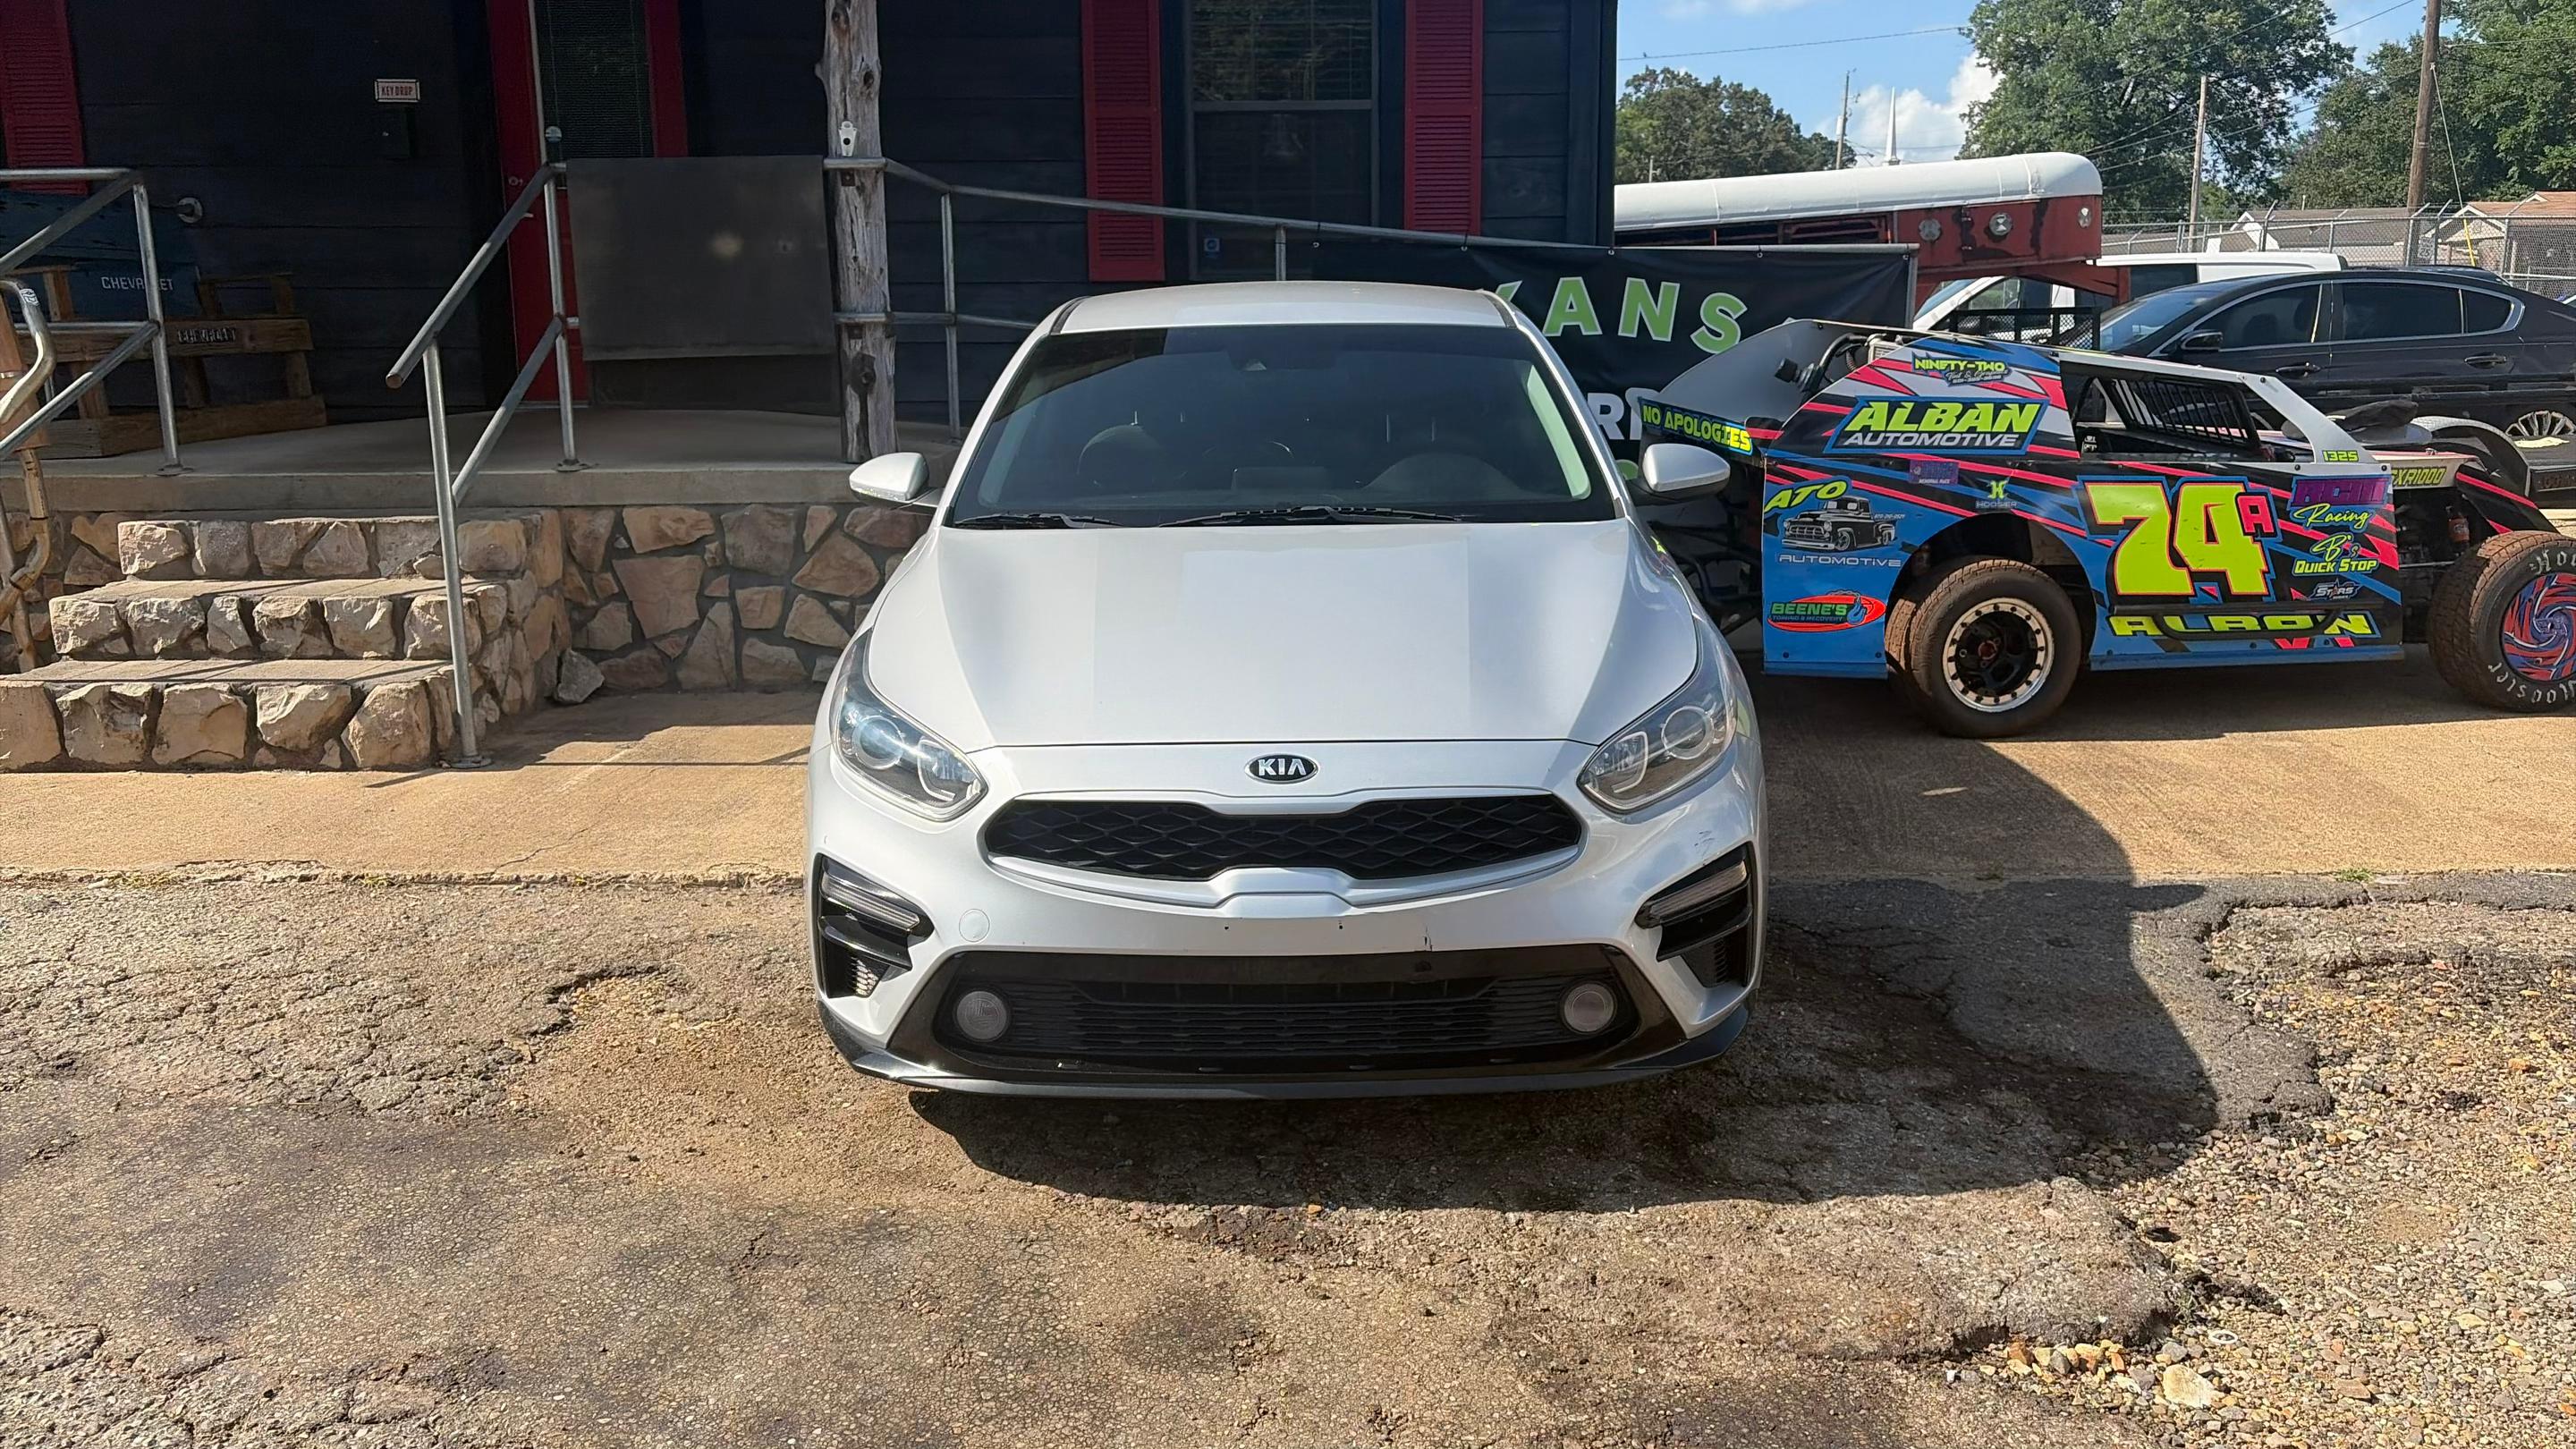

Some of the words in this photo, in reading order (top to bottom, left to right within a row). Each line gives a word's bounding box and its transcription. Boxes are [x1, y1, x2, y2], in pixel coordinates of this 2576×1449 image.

[381, 86, 394, 97] KEY
[394, 86, 412, 97] DROP
[101, 276, 174, 291] CHEVRET
[1845, 402, 2041, 432] ALBAN
[1643, 405, 1661, 425] NO
[1665, 411, 1751, 452] APOLOGIES
[1843, 432, 2020, 446] AUTOMOTIVE
[2323, 450, 2359, 462] 1325
[1764, 480, 1848, 512] ATO
[2293, 503, 2370, 529] Racing
[1779, 555, 1902, 567] AUTOMOTIVE
[1771, 603, 1848, 615] BEENE'S
[1258, 758, 1306, 775] KIA
